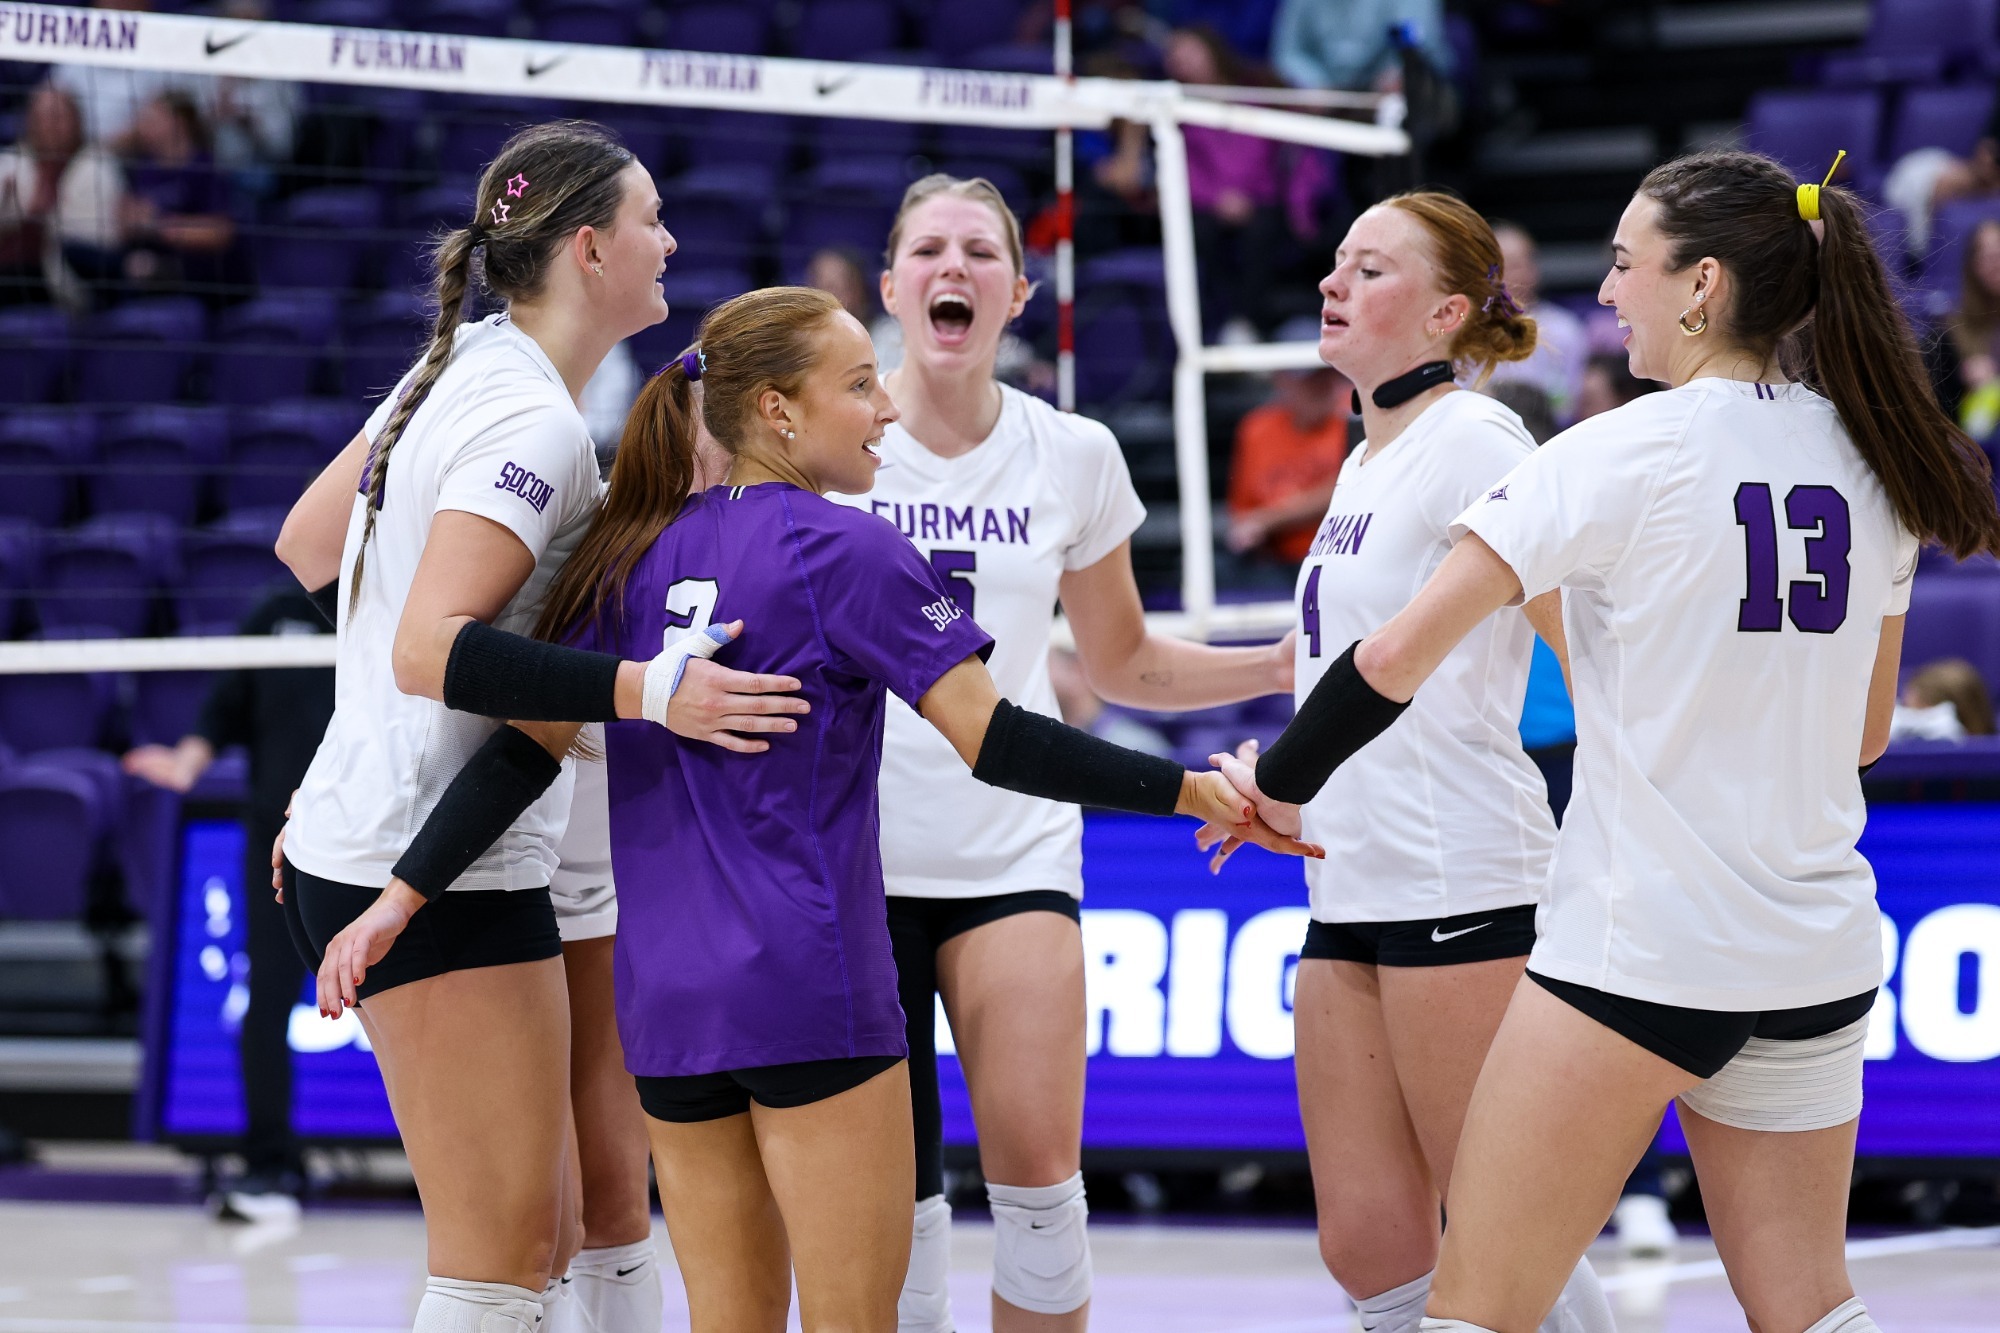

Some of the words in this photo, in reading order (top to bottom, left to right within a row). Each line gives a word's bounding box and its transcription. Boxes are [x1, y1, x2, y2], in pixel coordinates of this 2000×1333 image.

[930, 549, 976, 621] 5
[1733, 482, 1851, 634] 13
[1302, 565, 1322, 658] 4
